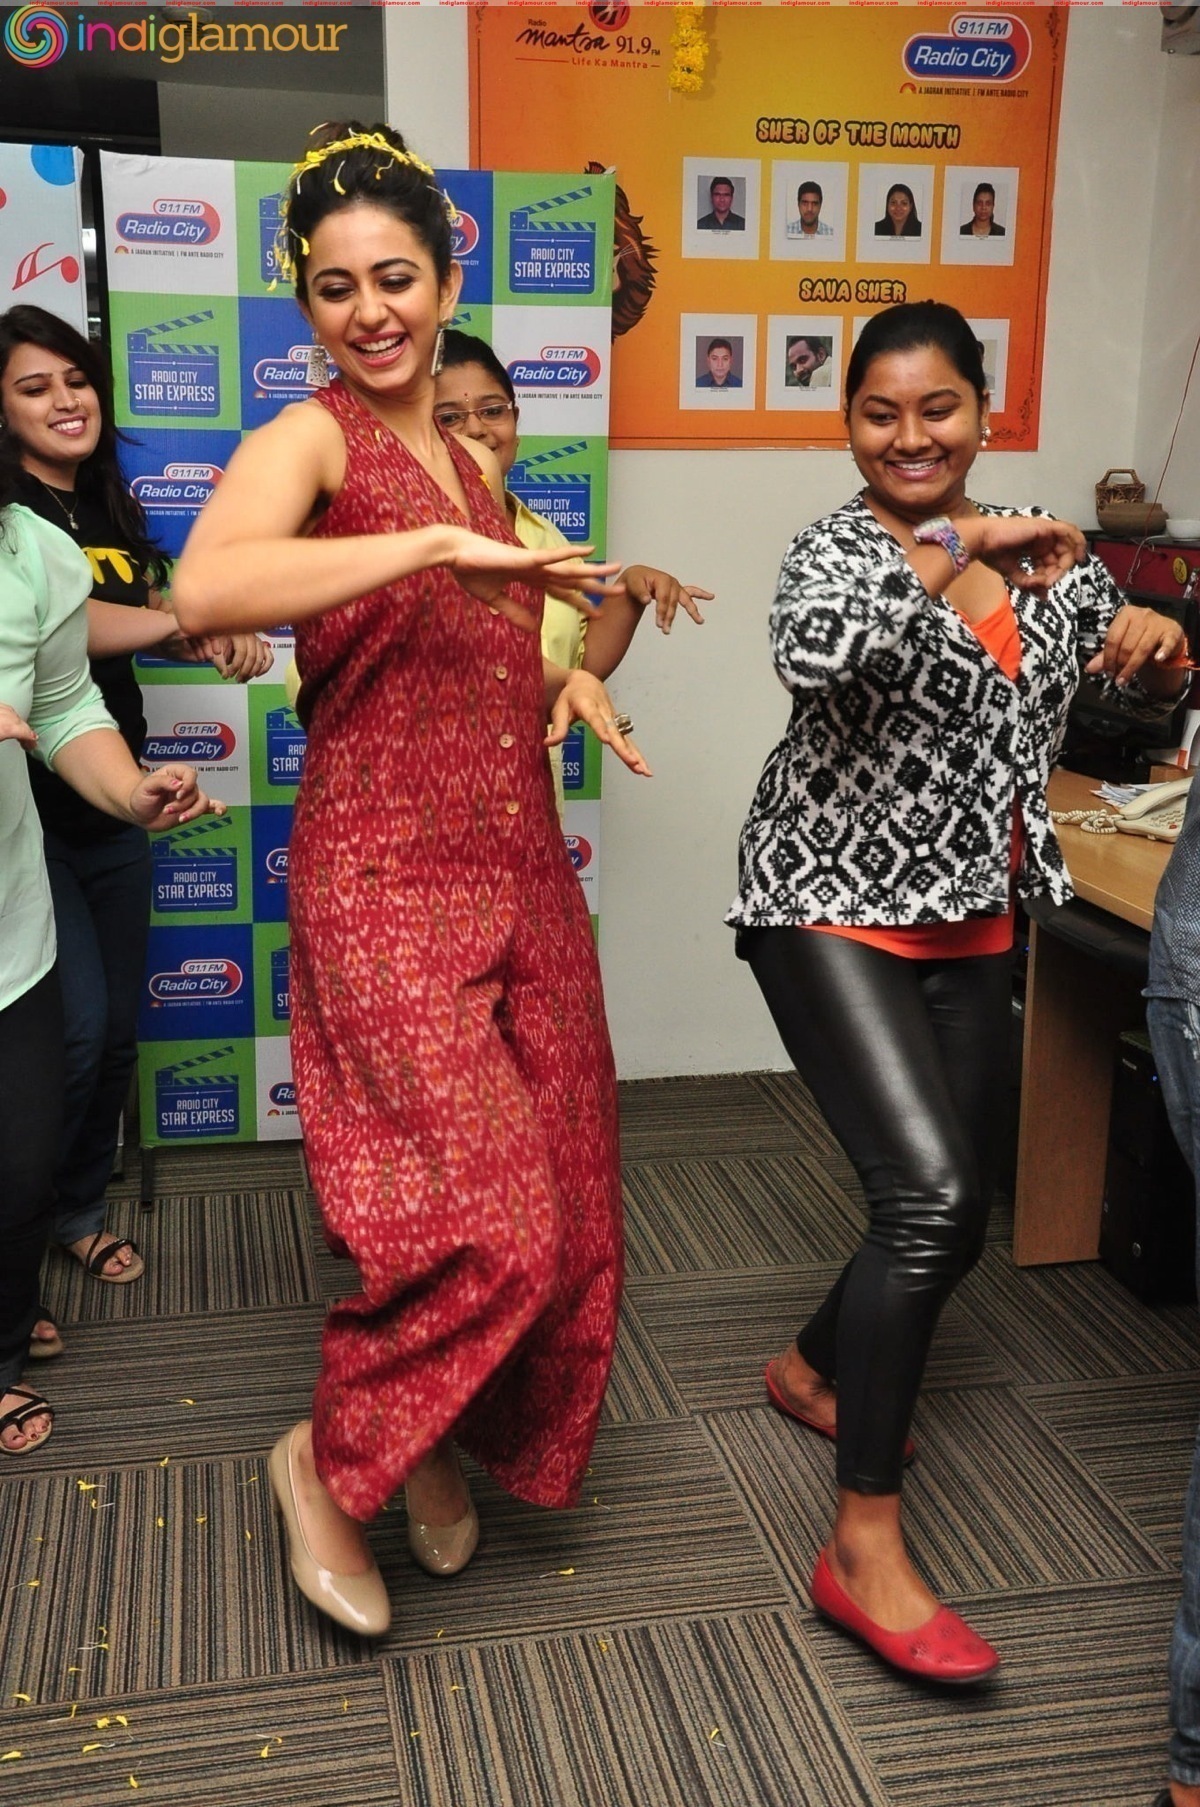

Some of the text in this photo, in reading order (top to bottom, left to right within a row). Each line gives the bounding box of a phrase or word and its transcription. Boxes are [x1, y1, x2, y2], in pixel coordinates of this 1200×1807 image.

[528, 18, 547, 27] Radio
[957, 21, 1009, 35] 91.1 FM
[616, 35, 652, 55] 91.9
[610, 59, 648, 69] Mantra
[913, 45, 1011, 77] Radio City
[756, 117, 961, 149] SHER OF THE MONTH
[158, 202, 201, 214] 91.1 FM
[124, 219, 206, 243] Radio City
[530, 247, 575, 261] RADIO CITY
[514, 262, 590, 279] STAR EXPRESS
[855, 279, 907, 304] SHER
[545, 350, 584, 359] 91.1 FM
[151, 370, 198, 384] RADIO CITY
[263, 367, 305, 380] Radio
[513, 366, 587, 386] Radio City
[134, 384, 215, 402] STAR EXPRESS
[170, 468, 210, 478] 91.1 FM
[139, 484, 215, 503] Radio City
[528, 499, 571, 510] RADIO CITY
[178, 725, 218, 735] 91.1 FM
[146, 741, 222, 760] Radio City
[288, 744, 307, 756] RAD
[272, 757, 299, 772] STAR
[173, 871, 216, 883] RADIO CITY
[158, 883, 233, 899] STAR EXPRESS
[187, 964, 224, 973] 91.1 FM
[158, 978, 228, 994] Radio City
[176, 1098, 219, 1110] RADIO CITY
[161, 1110, 235, 1126] STAR EXPRESS
